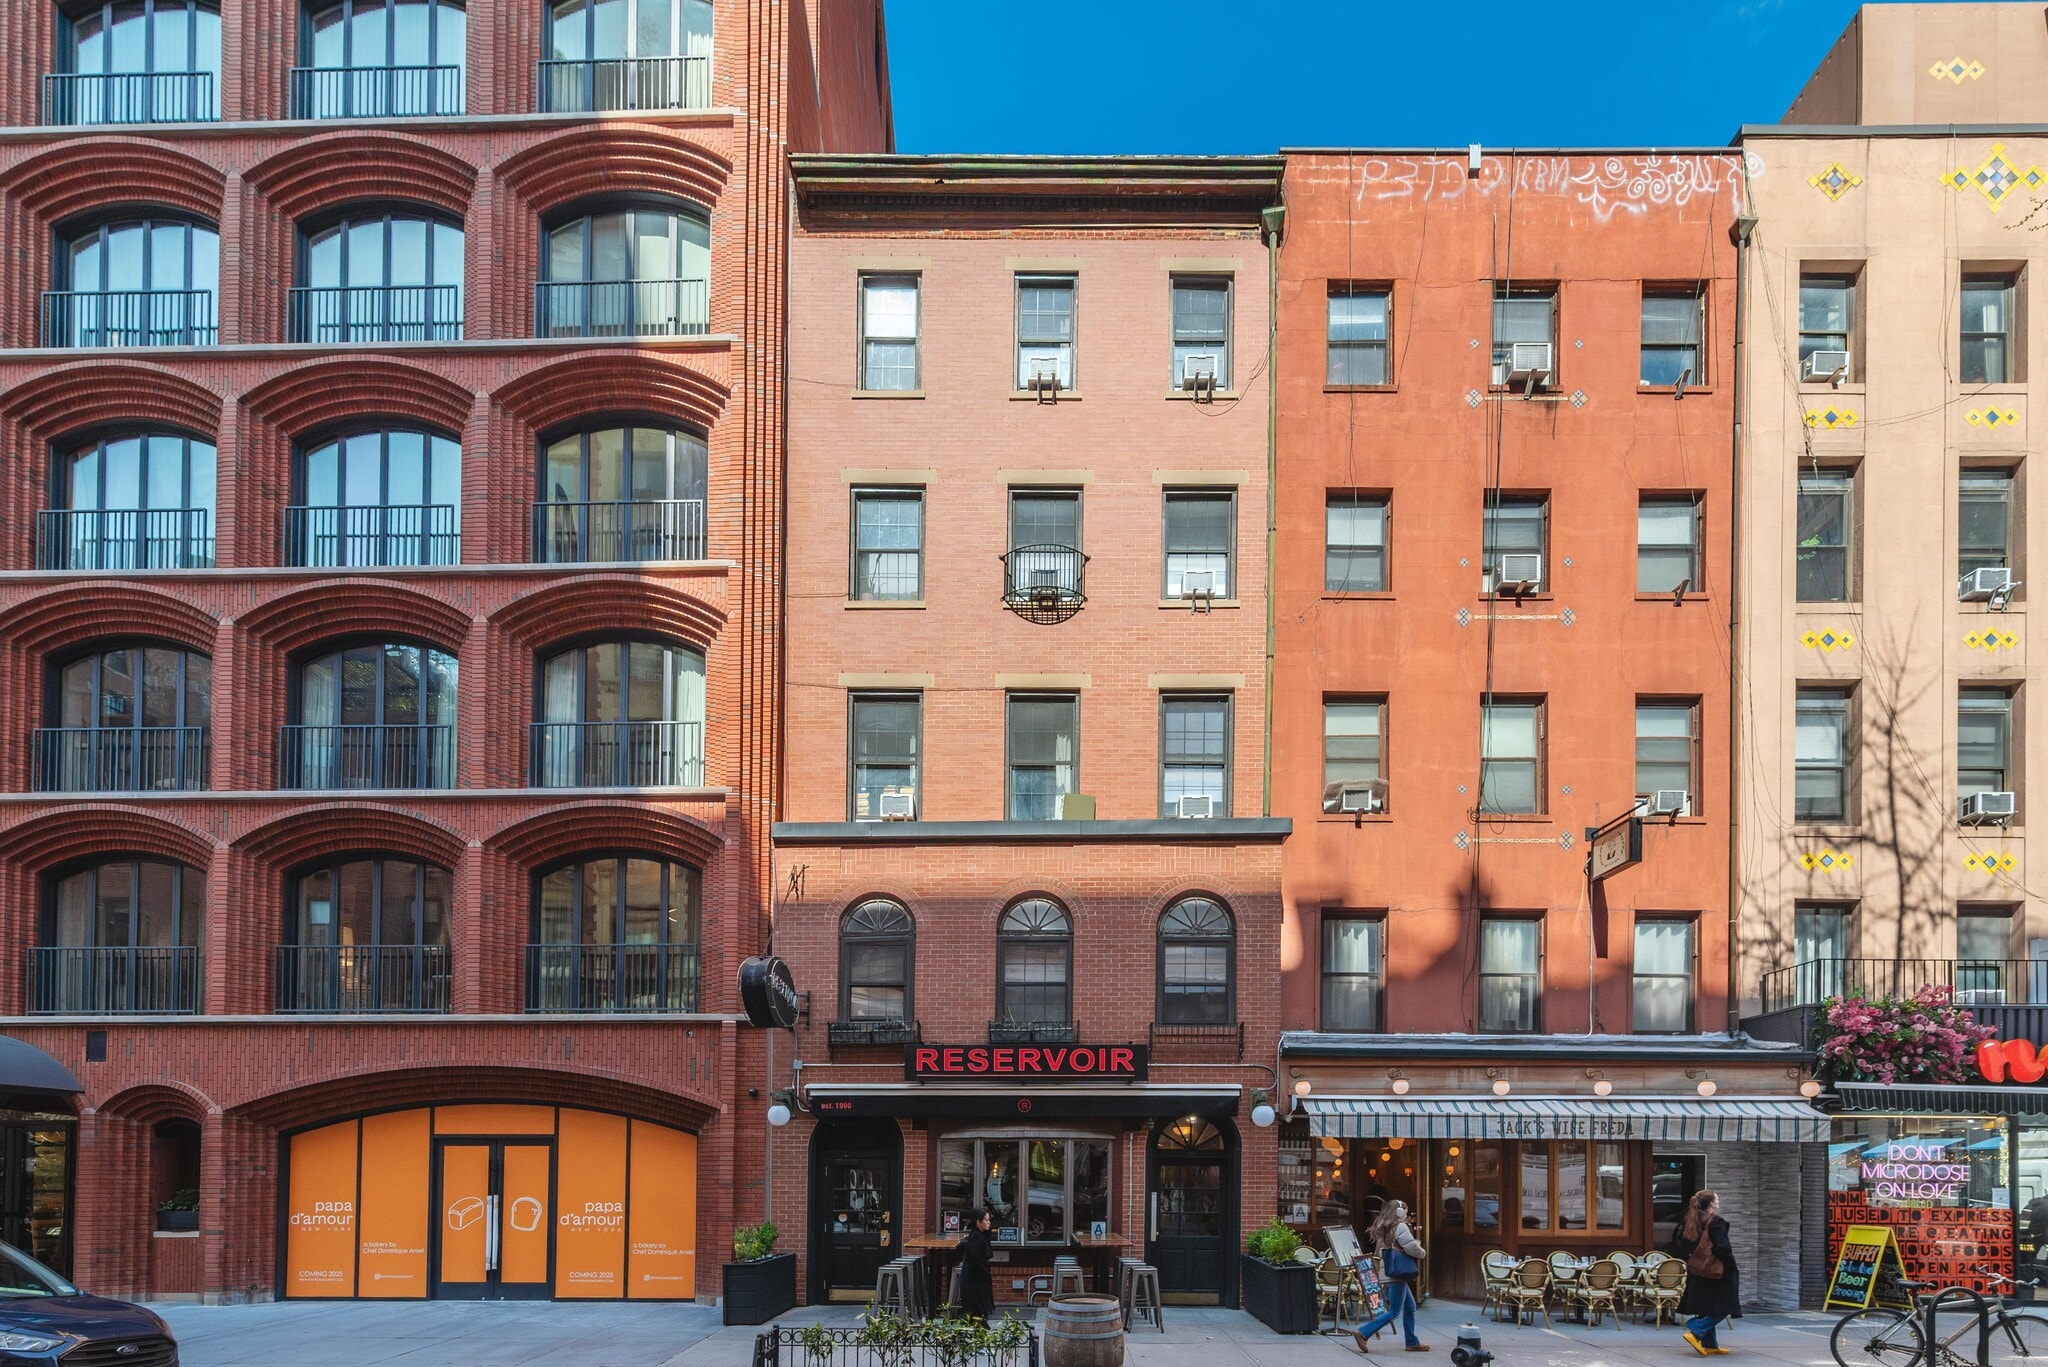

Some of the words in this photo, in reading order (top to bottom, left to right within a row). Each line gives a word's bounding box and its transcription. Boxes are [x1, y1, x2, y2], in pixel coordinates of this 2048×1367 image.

[915, 1048, 1135, 1072] RESERVOIR
[1497, 1121, 1545, 1135] JACK'S
[1552, 1121, 1585, 1135] WIFE
[1593, 1121, 1634, 1136] FREDA
[1890, 1144, 1945, 1161] DON'T
[1861, 1163, 1972, 1181] MICRODOSE
[1876, 1182, 1906, 1198] ON
[1911, 1182, 1959, 1199] LOVE
[315, 1201, 353, 1213] papa
[585, 1201, 624, 1213] papa
[1296, 1206, 1305, 1217] A
[290, 1213, 353, 1225] d'amour
[560, 1213, 624, 1226] d'amour
[1901, 1209, 1922, 1221] TO
[1931, 1210, 2012, 1222] EXPRESS
[1094, 1224, 1103, 1236] A
[1946, 1228, 2012, 1240] EATING
[1843, 1244, 1880, 1262] BUFFET
[1952, 1245, 2012, 1257] FOODS
[1906, 1262, 1949, 1274] OPEN
